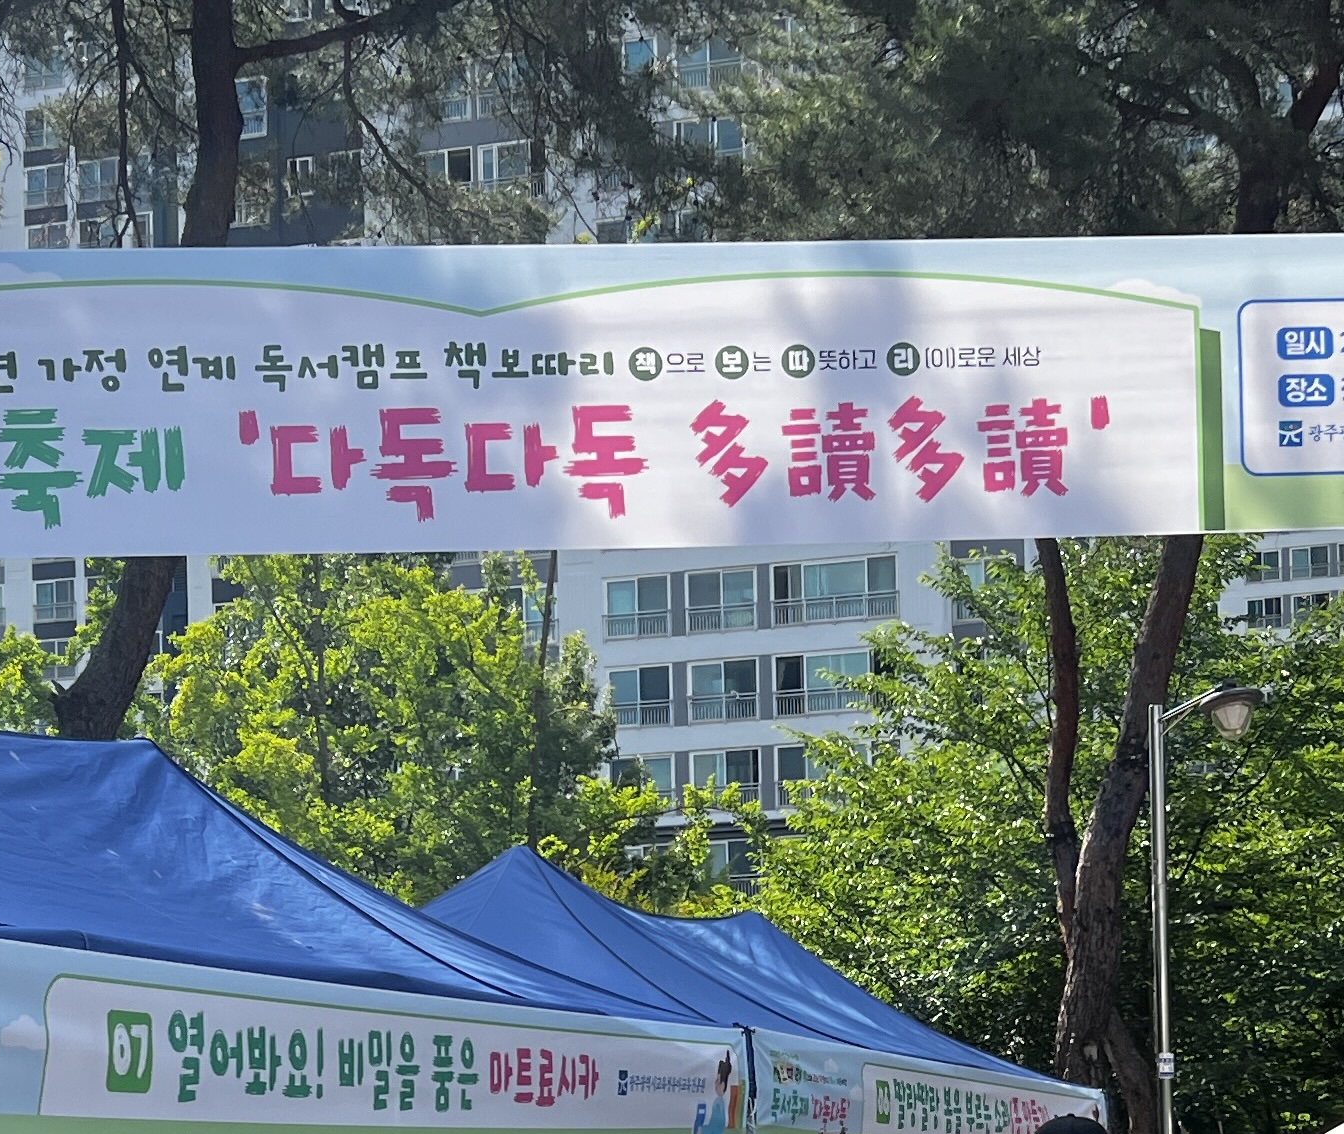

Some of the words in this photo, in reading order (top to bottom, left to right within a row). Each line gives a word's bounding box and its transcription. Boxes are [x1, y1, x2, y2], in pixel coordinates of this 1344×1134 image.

[38, 346, 127, 393] 가정
[148, 344, 237, 393] 연계
[255, 341, 429, 393] 독서캠프
[1001, 345, 1042, 368] 세상
[1283, 330, 1328, 357] 일시
[1284, 377, 1330, 403] 장소
[238, 404, 650, 524] '다독다독
[112, 1022, 149, 1079] 07
[167, 1009, 324, 1103] 열어봐요!
[337, 1029, 421, 1112] 비밀을
[430, 1035, 480, 1113] 품은
[489, 1047, 600, 1108] 마트료시카
